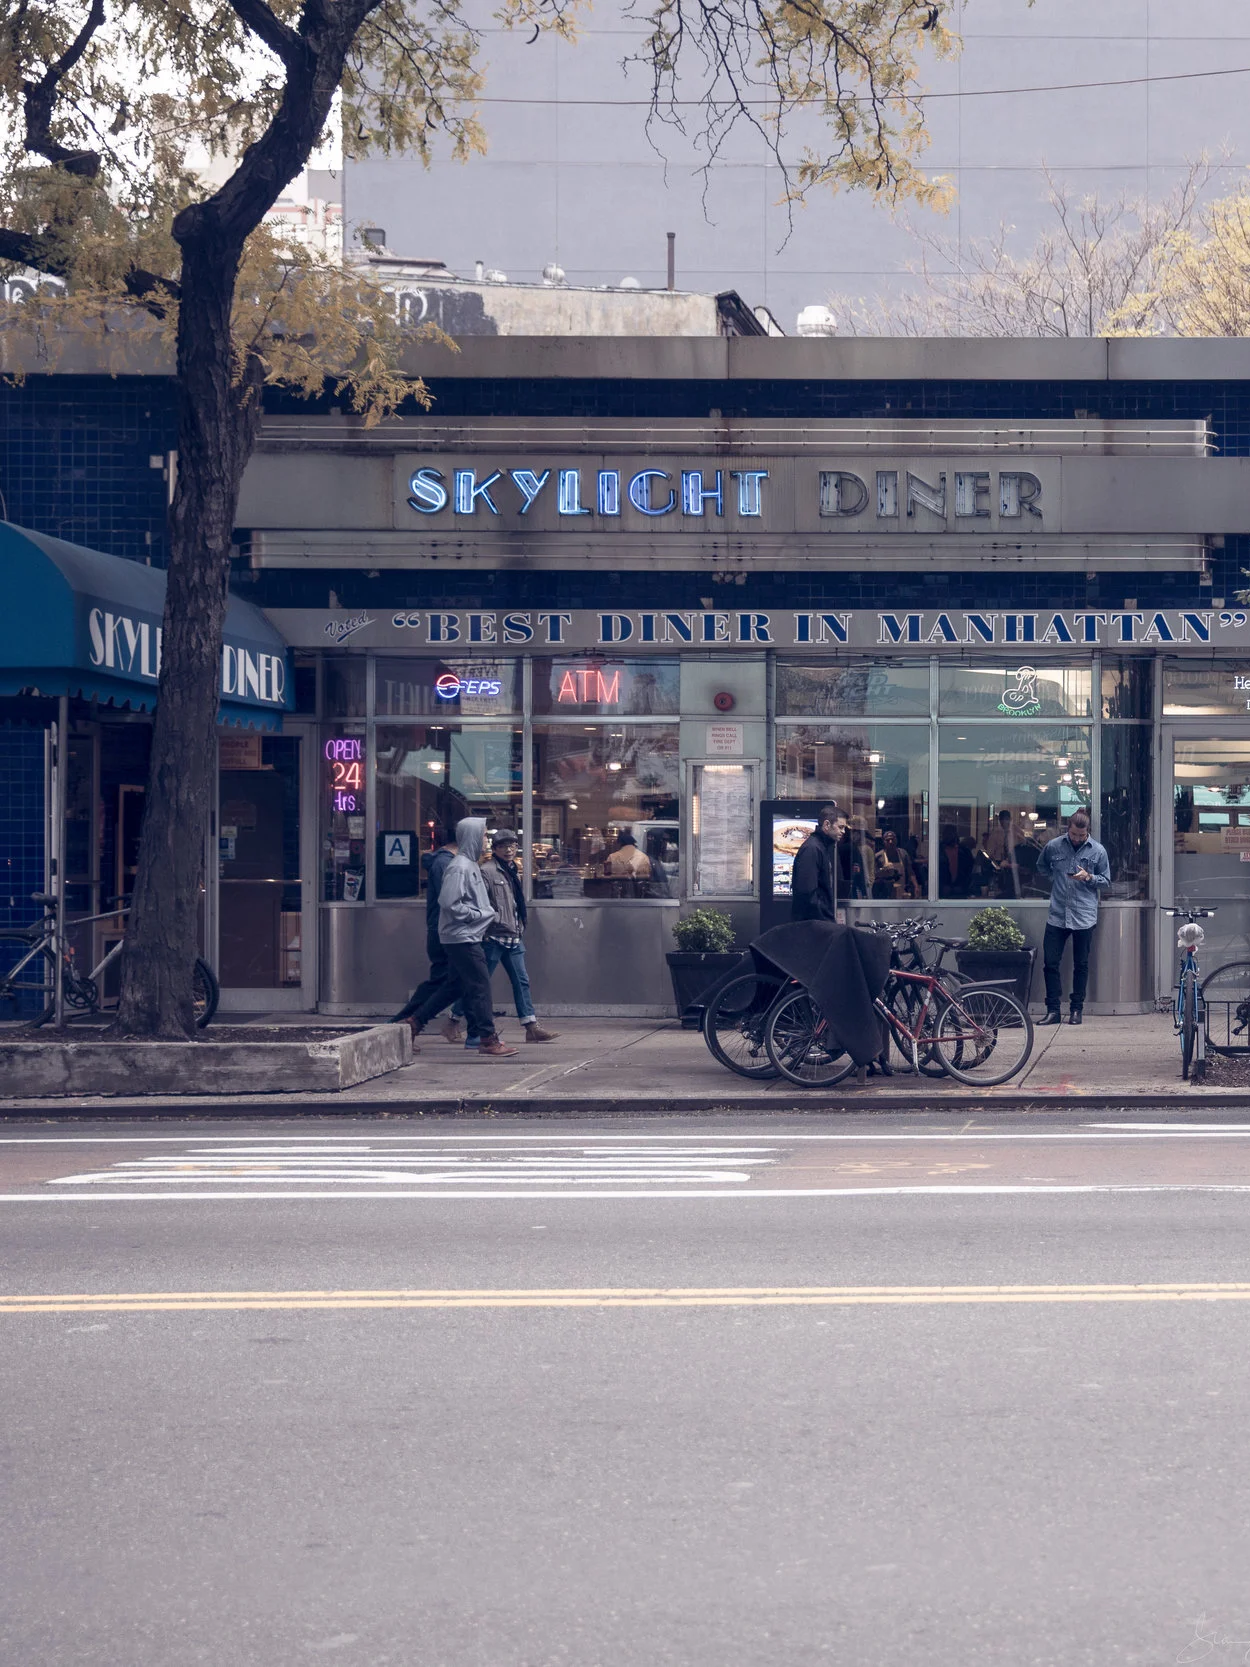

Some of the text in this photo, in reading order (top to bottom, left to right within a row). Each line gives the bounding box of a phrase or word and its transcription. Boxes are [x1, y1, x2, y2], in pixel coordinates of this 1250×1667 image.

[407, 466, 1044, 519] SKYLIGHT DINER
[324, 609, 369, 638] Voted
[597, 611, 775, 644] DINER
[793, 611, 853, 644] IN
[222, 644, 285, 703] DINER
[557, 670, 620, 703] ATM
[997, 703, 1041, 716] BROOKLYN
[325, 739, 362, 760] OPEN
[332, 762, 361, 790] 24
[388, 837, 406, 857] A
